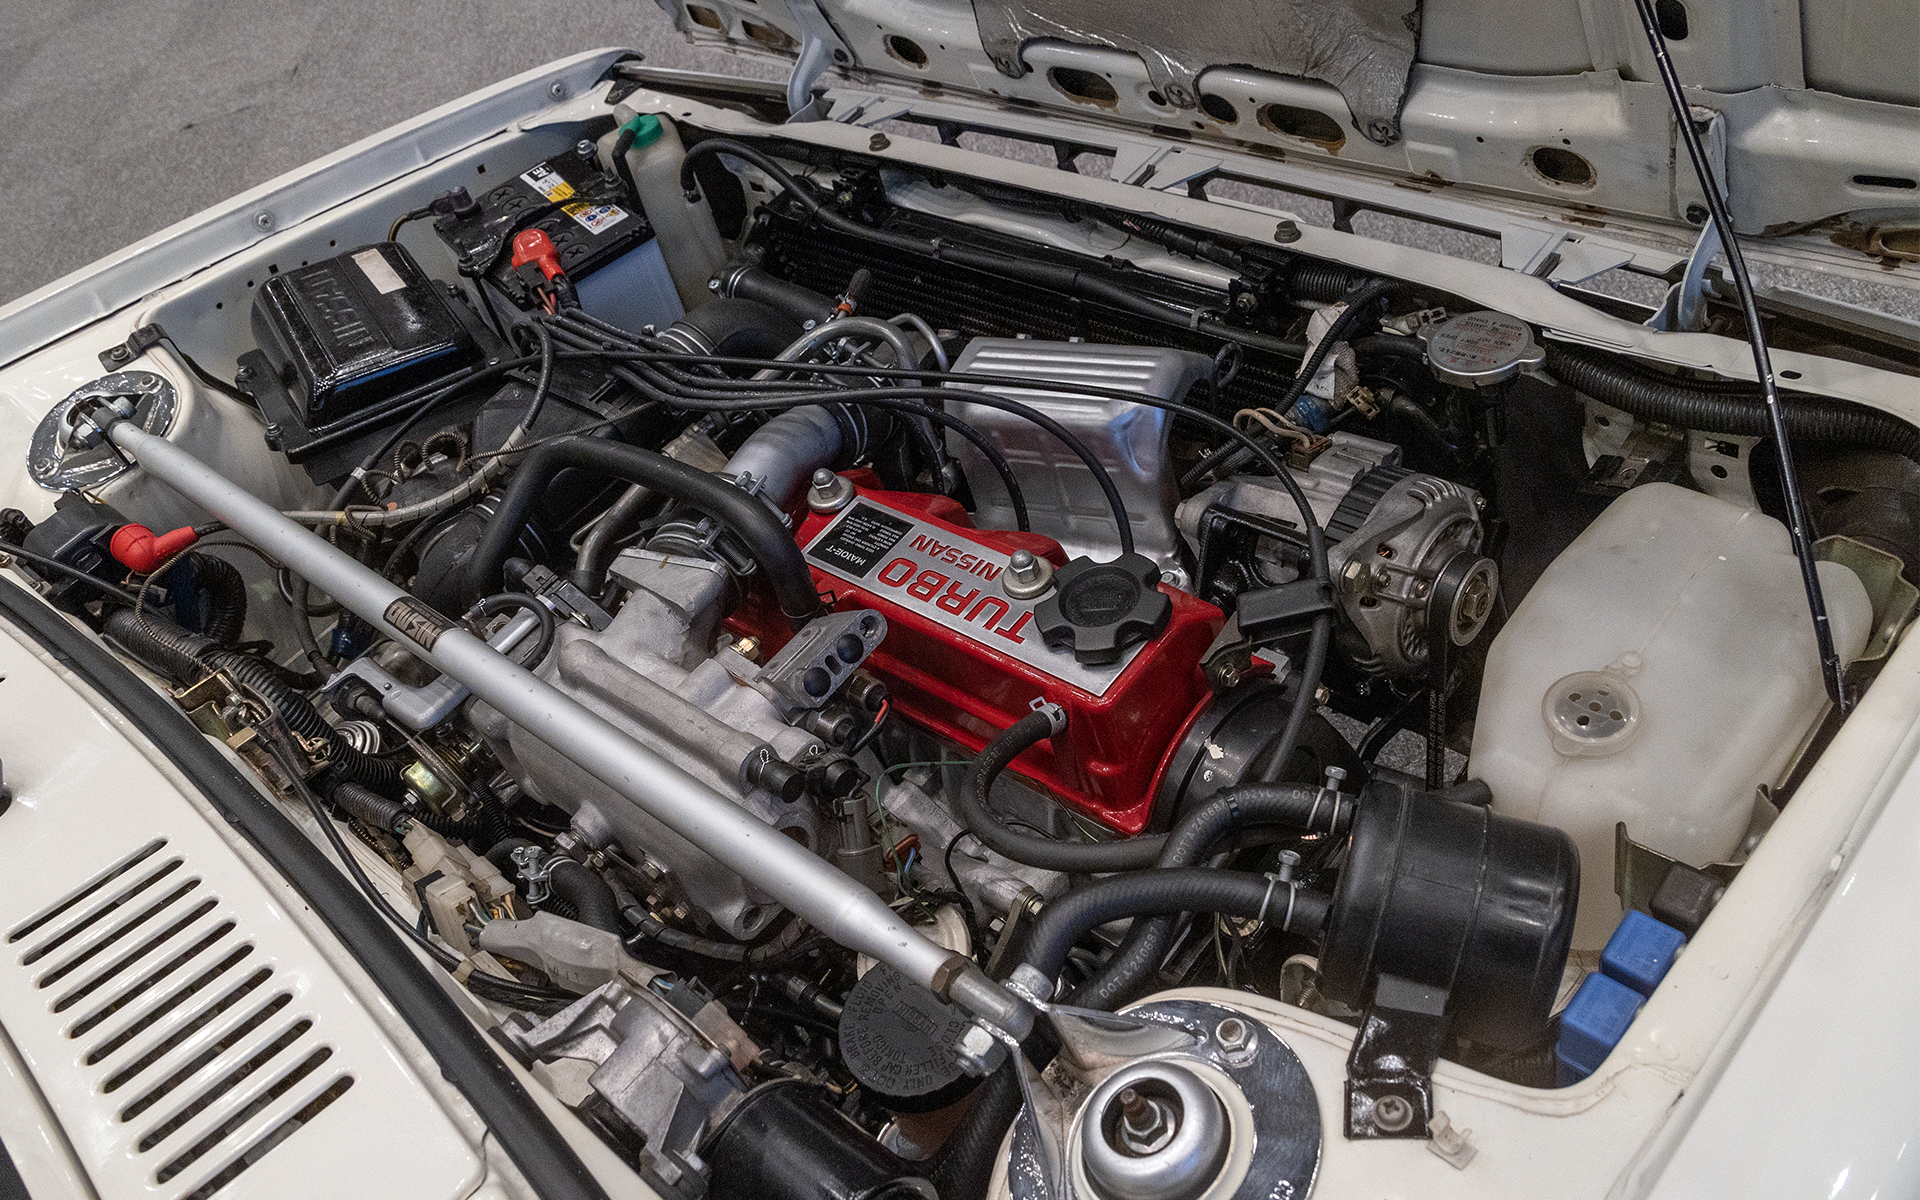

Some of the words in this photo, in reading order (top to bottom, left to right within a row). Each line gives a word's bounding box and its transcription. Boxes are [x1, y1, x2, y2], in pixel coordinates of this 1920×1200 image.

[824, 544, 867, 565] MA10E-T
[909, 534, 1003, 582] NISSAN
[877, 557, 1034, 645] TURBO
[386, 600, 442, 650] NISMO
[1173, 836, 1190, 863] DOT
[848, 980, 873, 1013] FLUID
[859, 971, 901, 1020] REMOVING
[872, 984, 903, 1014] OPEN
[1099, 977, 1121, 999] DOT
[896, 1003, 935, 1036] NISSAN
[843, 1022, 860, 1059] BRAKE
[857, 1027, 882, 1066] BEFORE
[874, 1035, 905, 1063] TOKICO
[927, 1020, 960, 1057] CLOSE
[859, 1064, 871, 1075] 3
[868, 1071, 896, 1089] DOT
[881, 1062, 901, 1075] CAP
[903, 1075, 932, 1090] ONLY
